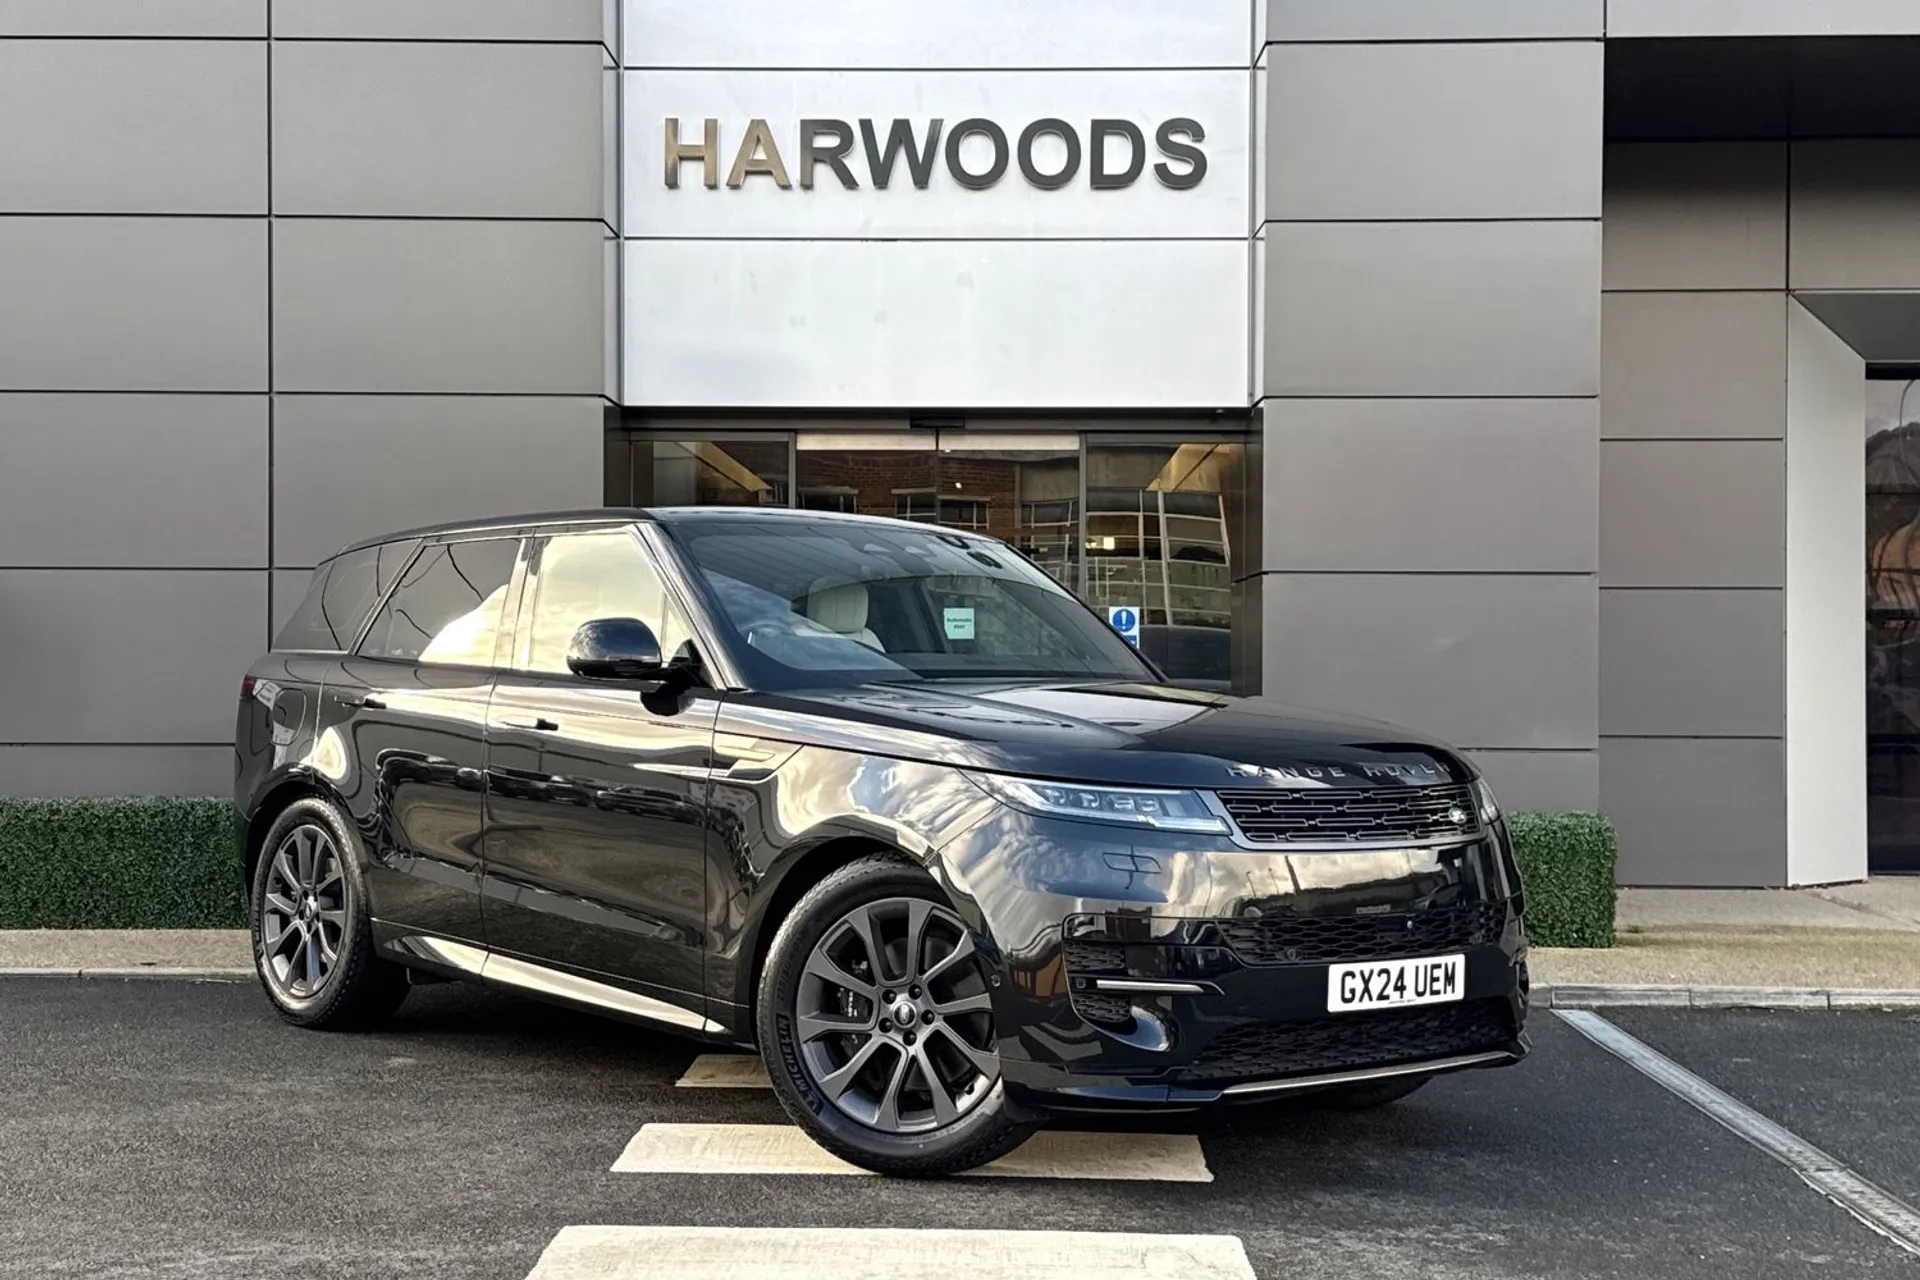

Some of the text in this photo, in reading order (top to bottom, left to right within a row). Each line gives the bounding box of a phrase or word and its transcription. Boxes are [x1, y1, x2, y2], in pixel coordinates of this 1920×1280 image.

[664, 117, 1208, 189] HARWOODS
[1223, 761, 1451, 778] RANGE ROVER
[1340, 961, 1456, 1004] GX24 UEM
[777, 1016, 809, 1092] MICHELIN
